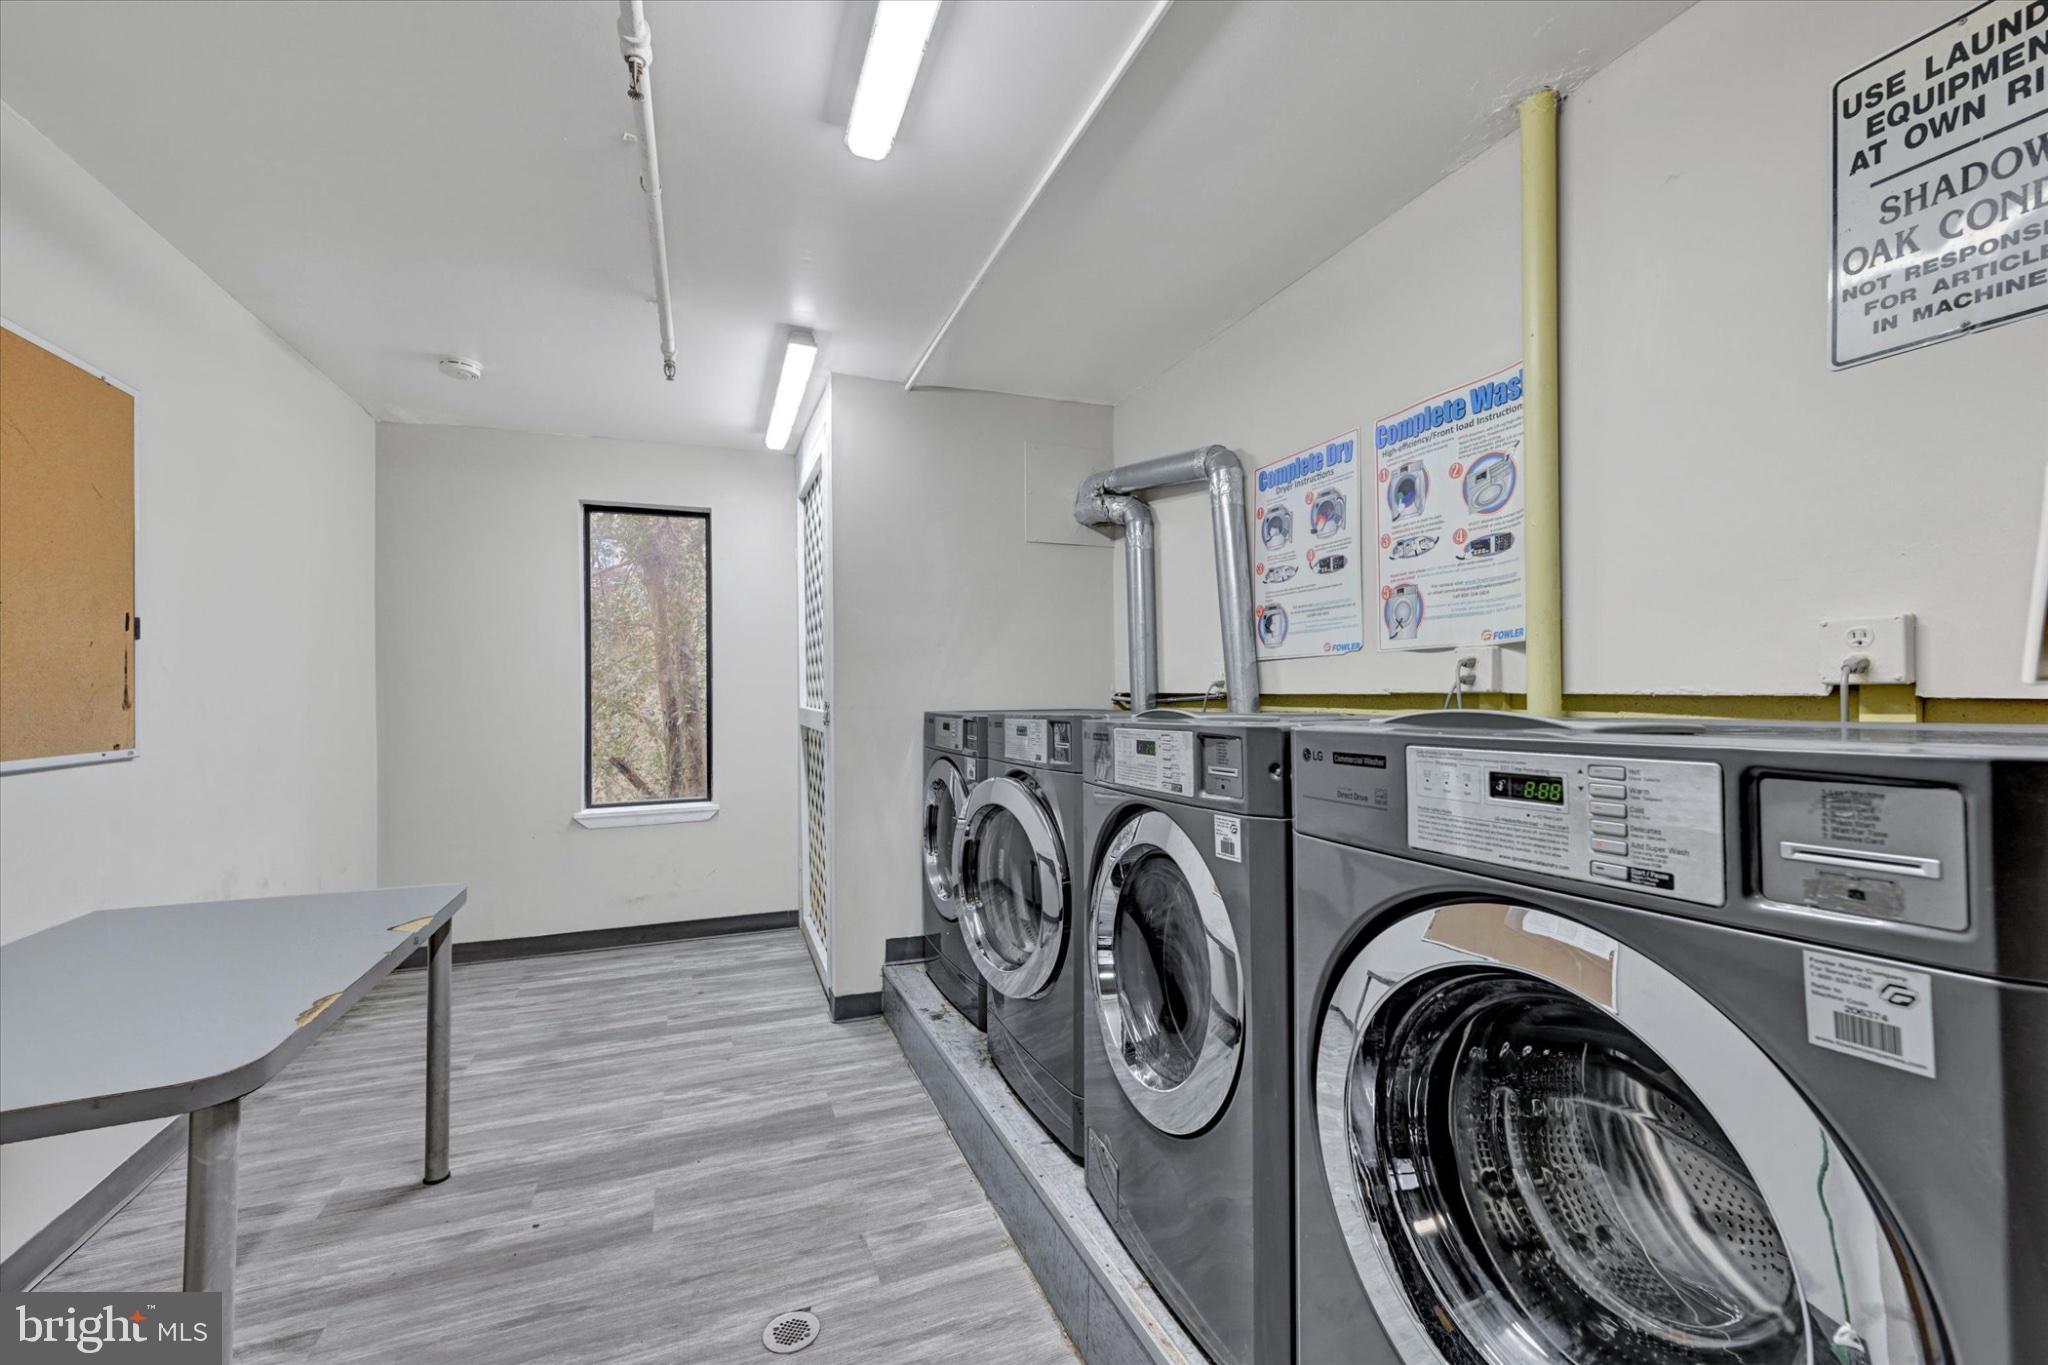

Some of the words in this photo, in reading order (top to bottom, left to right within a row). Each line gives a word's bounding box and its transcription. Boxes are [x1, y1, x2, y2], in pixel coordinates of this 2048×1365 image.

[1843, 69, 1906, 119] USE
[1925, 0, 2048, 81] LAUND
[1866, 30, 2048, 139] EQUIPMEN
[1849, 139, 1887, 176] AT
[1904, 94, 1985, 149] OWN
[2008, 65, 2044, 106] RI
[1879, 132, 2048, 225] SHADOW
[1843, 224, 1921, 275] OAK
[1842, 274, 1891, 302] NOT
[1864, 288, 1917, 316] FOR
[1873, 315, 1898, 334] IN
[1913, 268, 2048, 322] MACHINE
[1375, 397, 1467, 450] Complete
[1456, 418, 1475, 432] load
[1258, 452, 1324, 492] Complete
[1326, 439, 1354, 467] Dry
[1275, 483, 1294, 495] Dryer
[1294, 468, 1335, 488] Instructions
[1332, 642, 1360, 652] FOWLER
[1492, 627, 1524, 640] FOWLER
[1312, 750, 1324, 762] LG
[1630, 842, 1645, 850] Add
[1668, 847, 1690, 857] Wash
